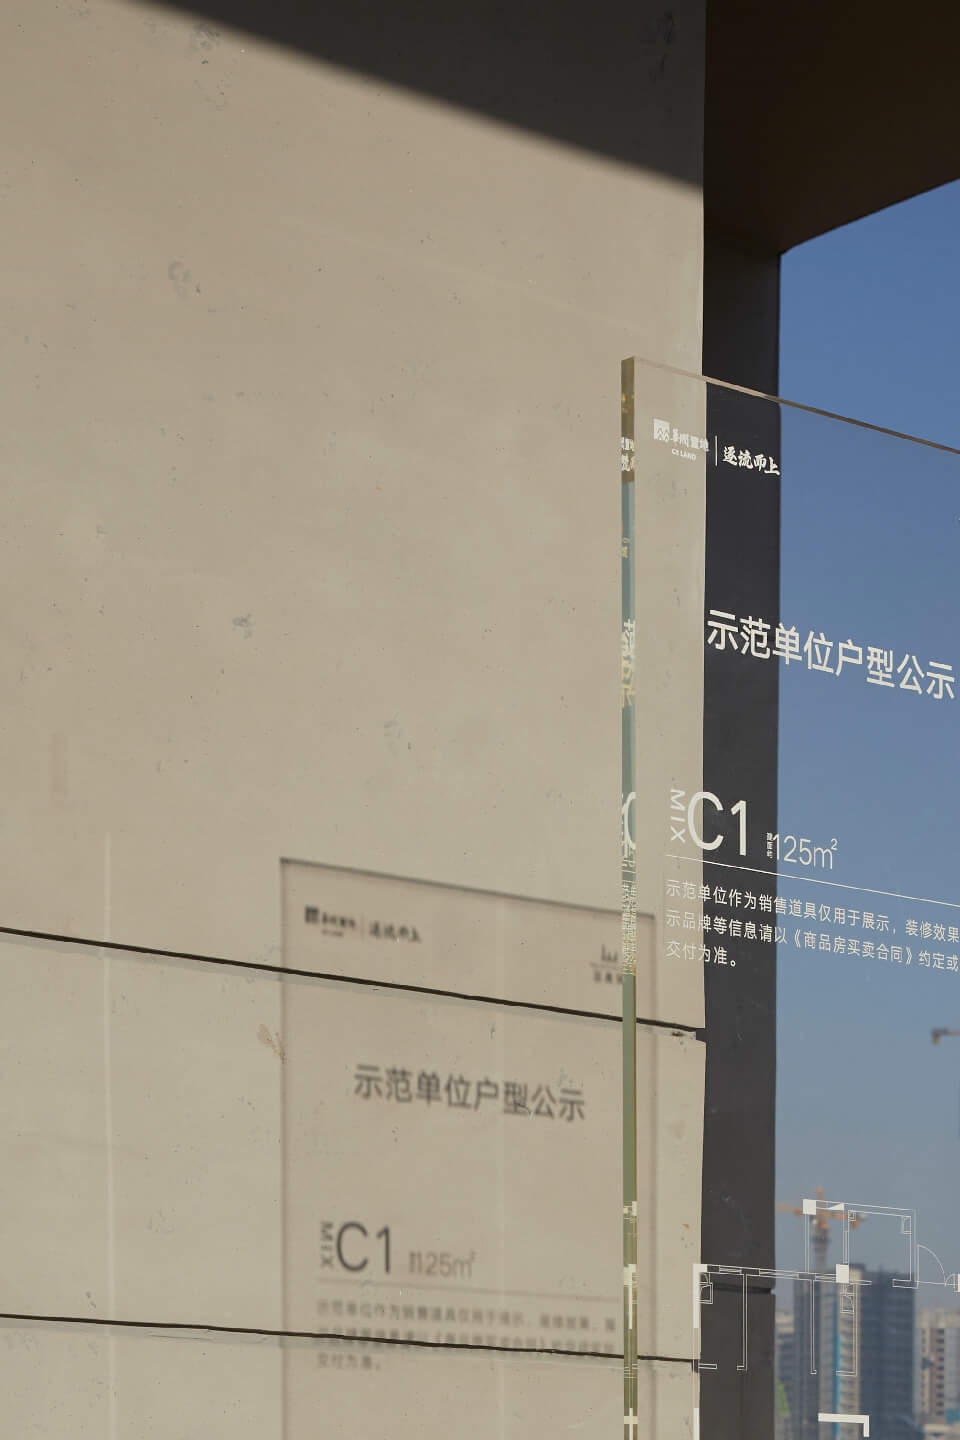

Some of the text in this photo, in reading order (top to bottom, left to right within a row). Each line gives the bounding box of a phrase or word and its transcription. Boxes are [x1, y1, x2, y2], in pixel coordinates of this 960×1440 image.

[707, 609, 956, 700] 示范单位户型公示
[670, 789, 687, 844] MIX
[687, 791, 748, 856] C1
